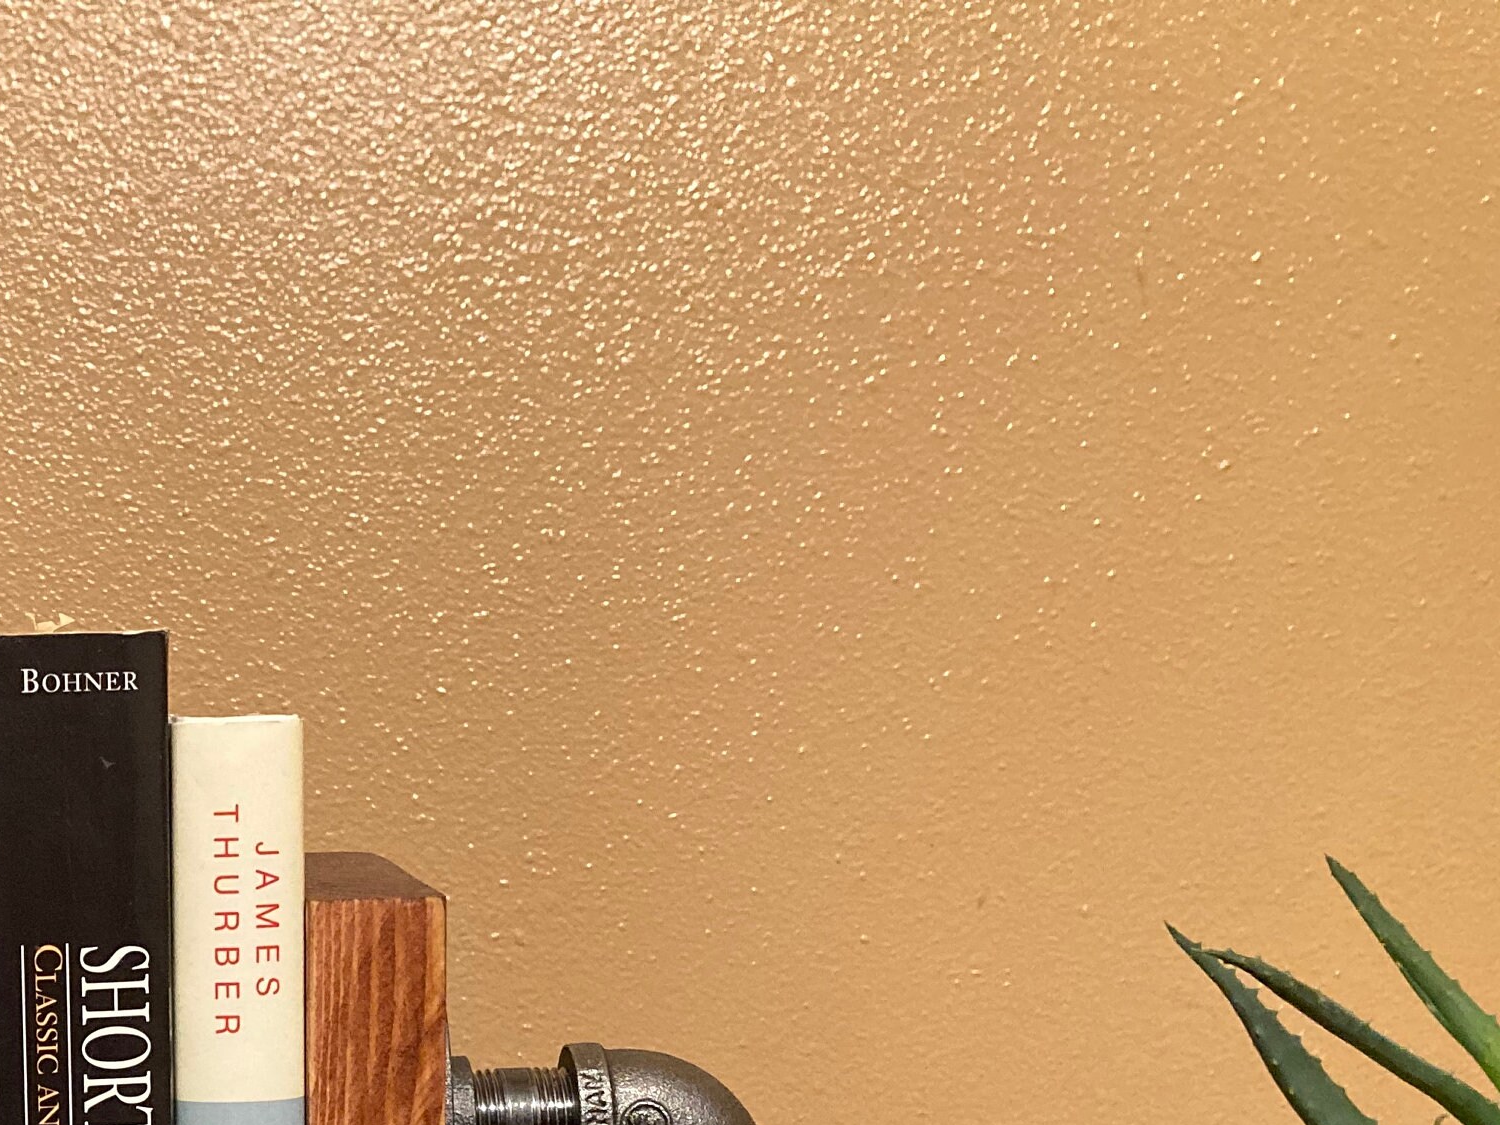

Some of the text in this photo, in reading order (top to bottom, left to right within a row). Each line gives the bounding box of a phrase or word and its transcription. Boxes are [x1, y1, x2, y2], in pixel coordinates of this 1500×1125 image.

[20, 667, 139, 694] BOHNER
[213, 803, 241, 1035] THURBER
[255, 841, 280, 996] JAMES
[33, 943, 64, 1075] CLASSIC
